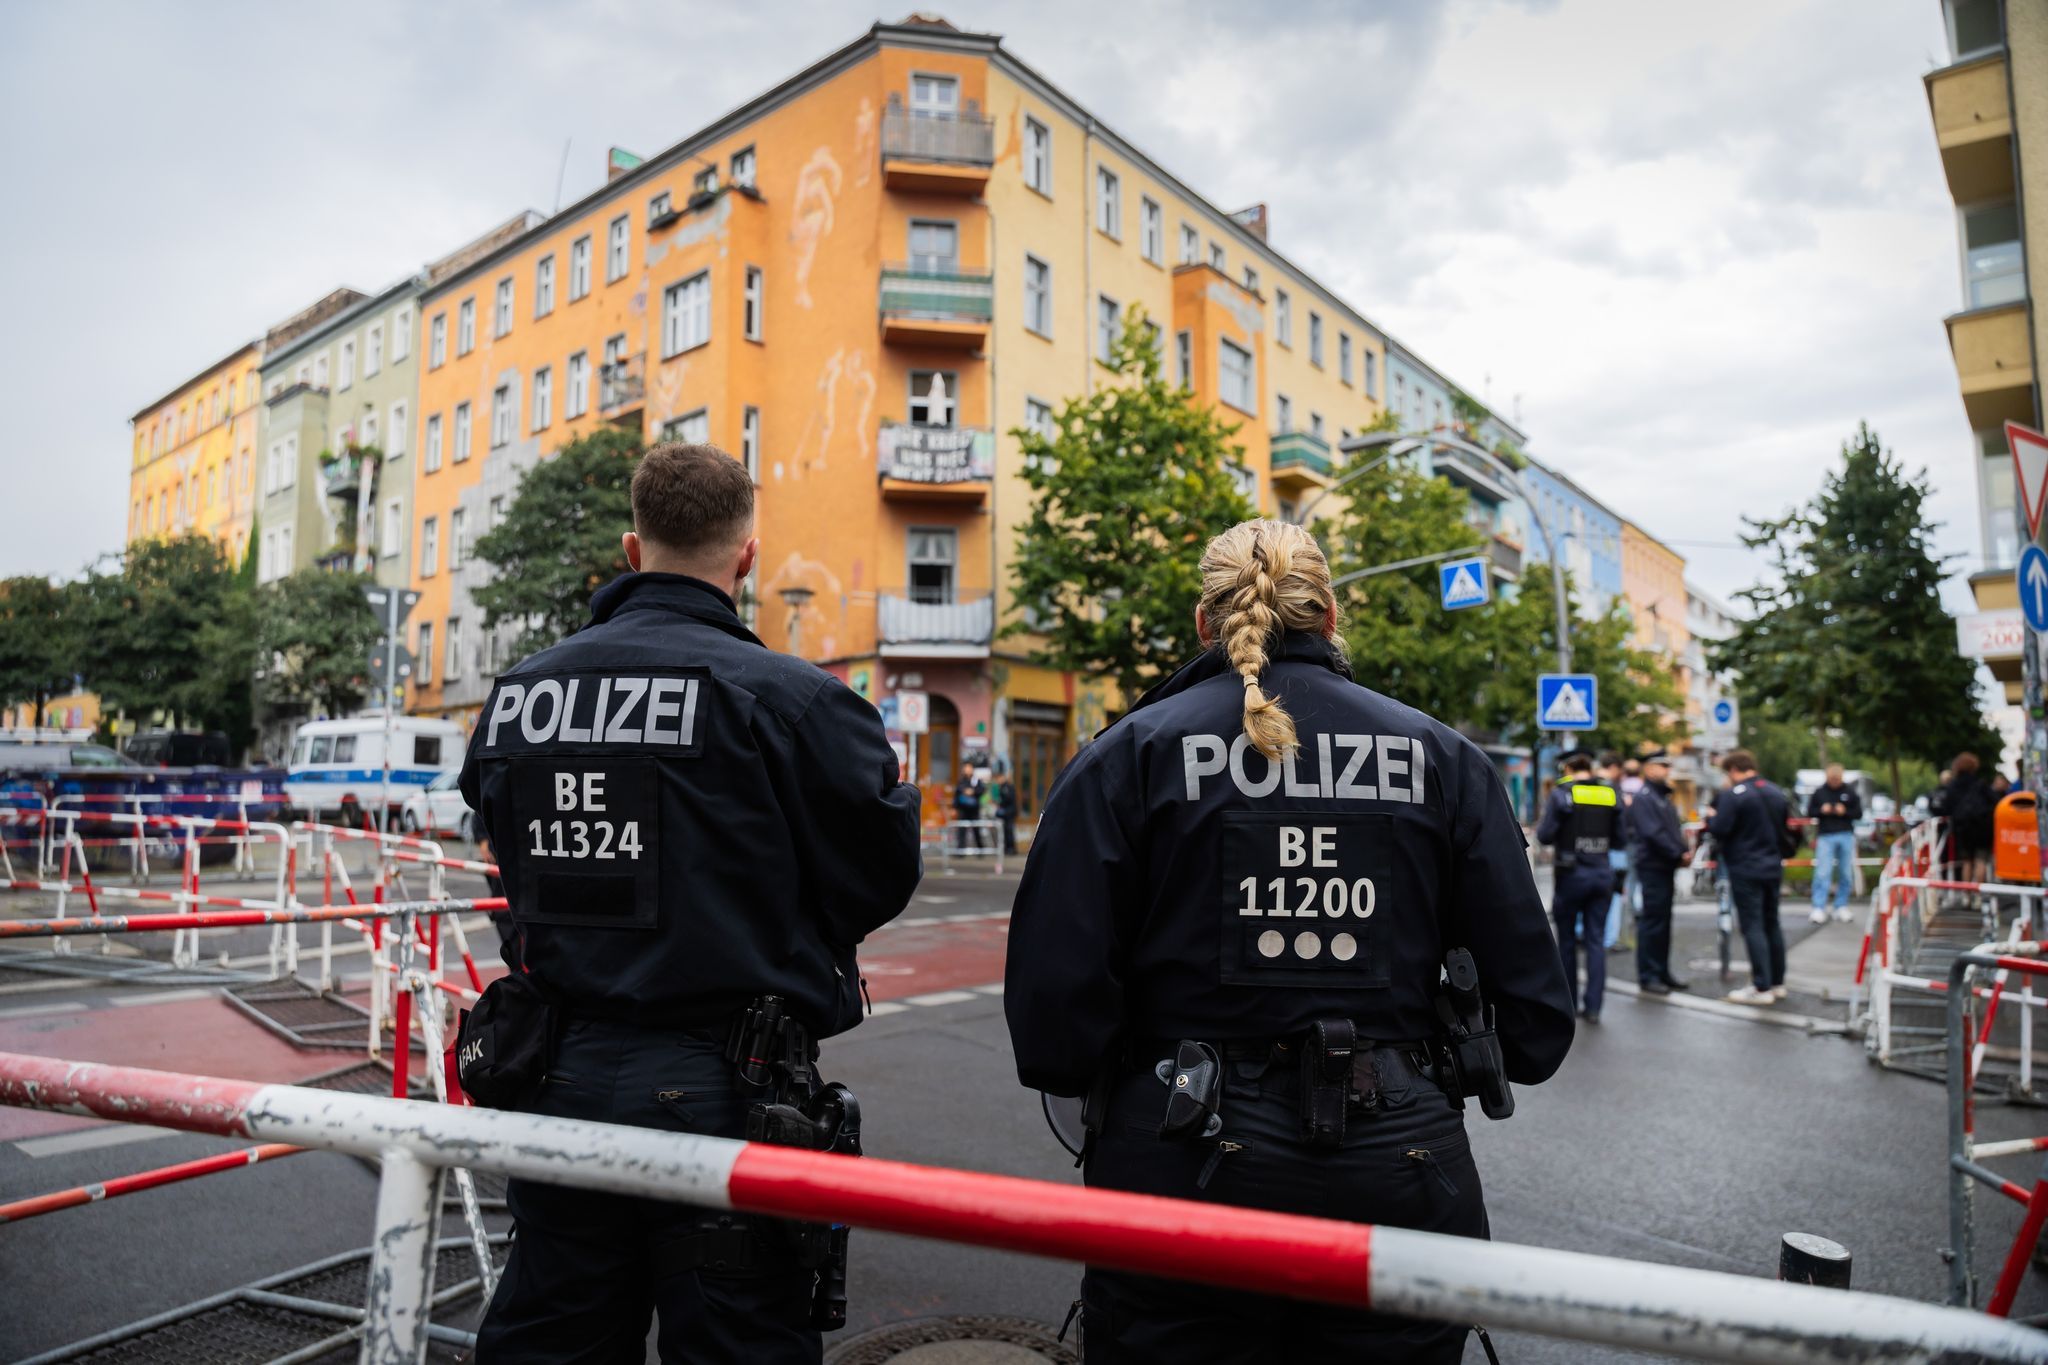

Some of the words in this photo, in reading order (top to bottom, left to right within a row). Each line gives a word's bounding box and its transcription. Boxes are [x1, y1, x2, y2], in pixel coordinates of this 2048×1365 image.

[486, 678, 698, 746] POLIZEI
[1182, 733, 1425, 804] POLIZEI
[554, 772, 607, 812] BE
[528, 819, 643, 860] 11324
[1279, 826, 1338, 868] BE
[1239, 876, 1376, 919] 11200
